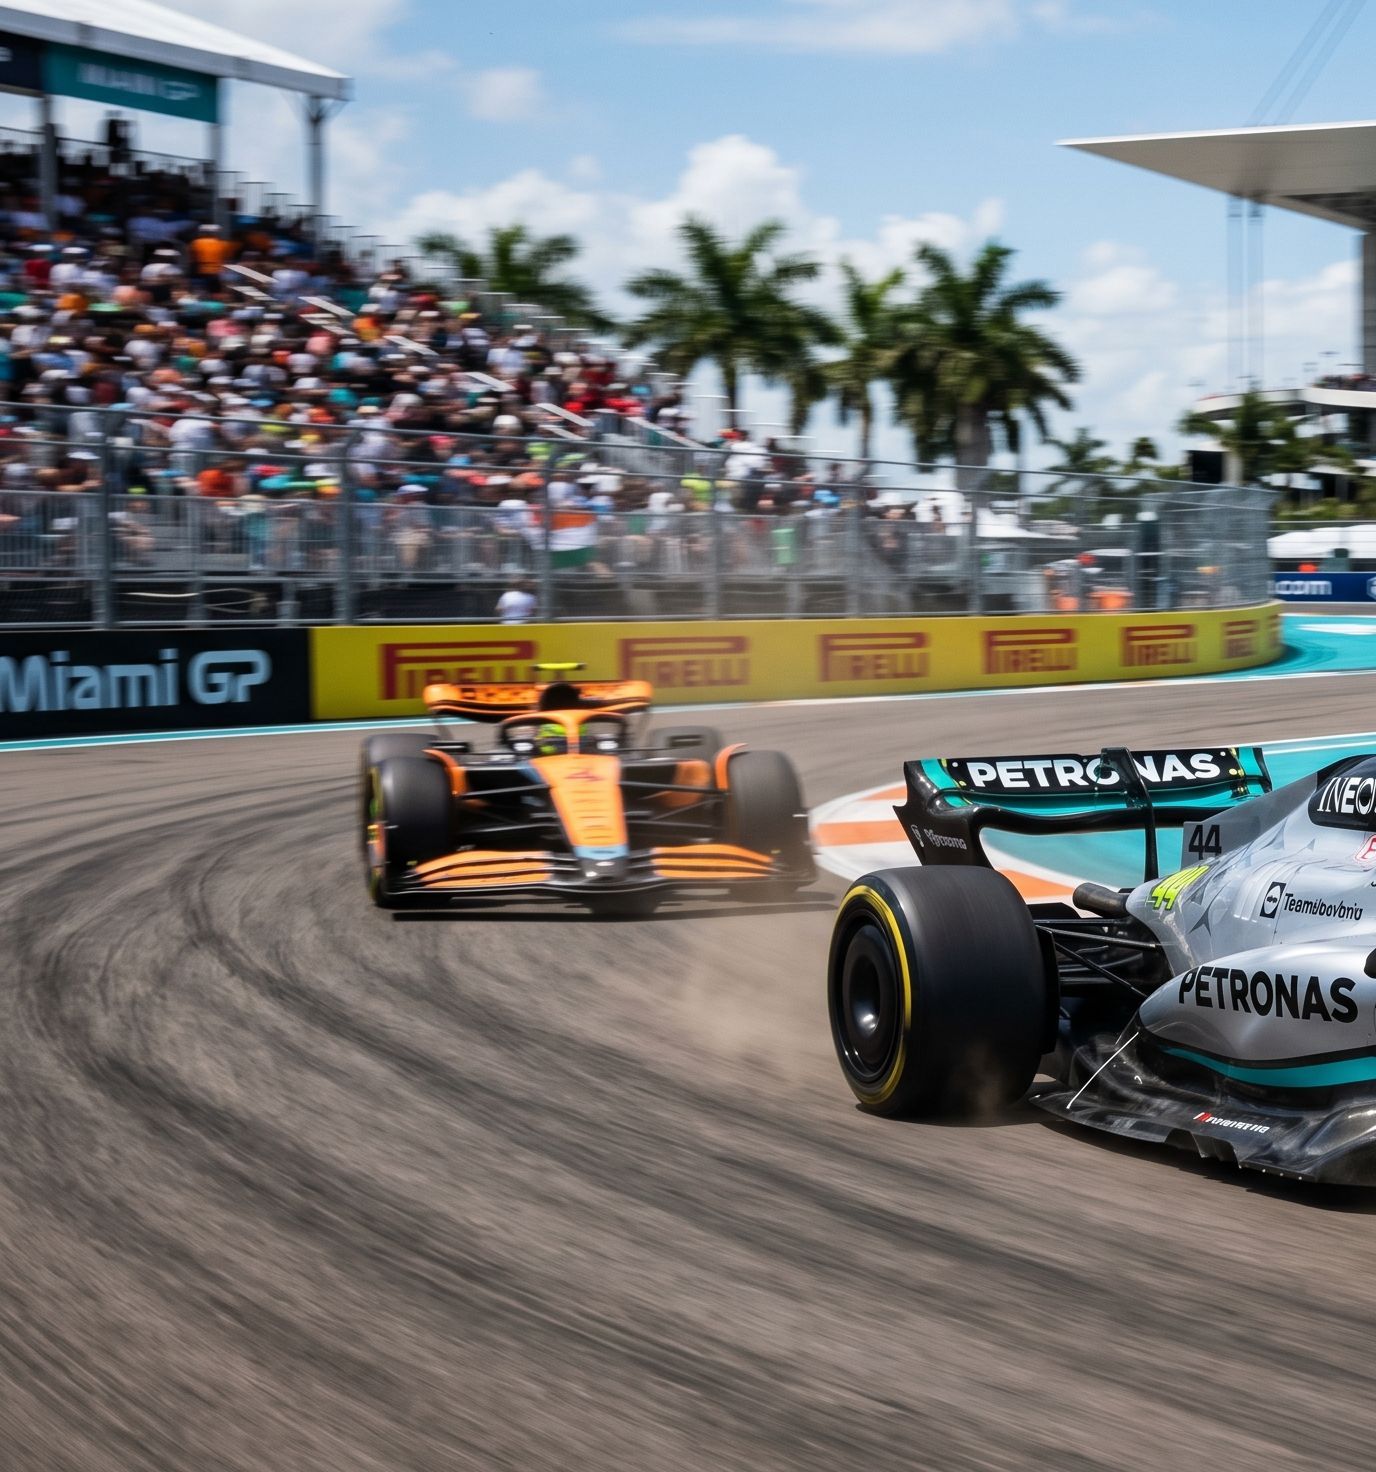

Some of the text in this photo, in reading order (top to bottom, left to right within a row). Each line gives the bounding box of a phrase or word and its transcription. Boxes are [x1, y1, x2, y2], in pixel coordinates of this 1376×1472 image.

[818, 632, 929, 682] PIRELLI
[983, 628, 1078, 674] PIRELLI
[0, 648, 272, 712] Miami GP
[966, 753, 1221, 788] PETRONAS
[1188, 824, 1222, 860] 44
[1151, 864, 1210, 910] 44
[1178, 966, 1359, 1023] PETRONAS
